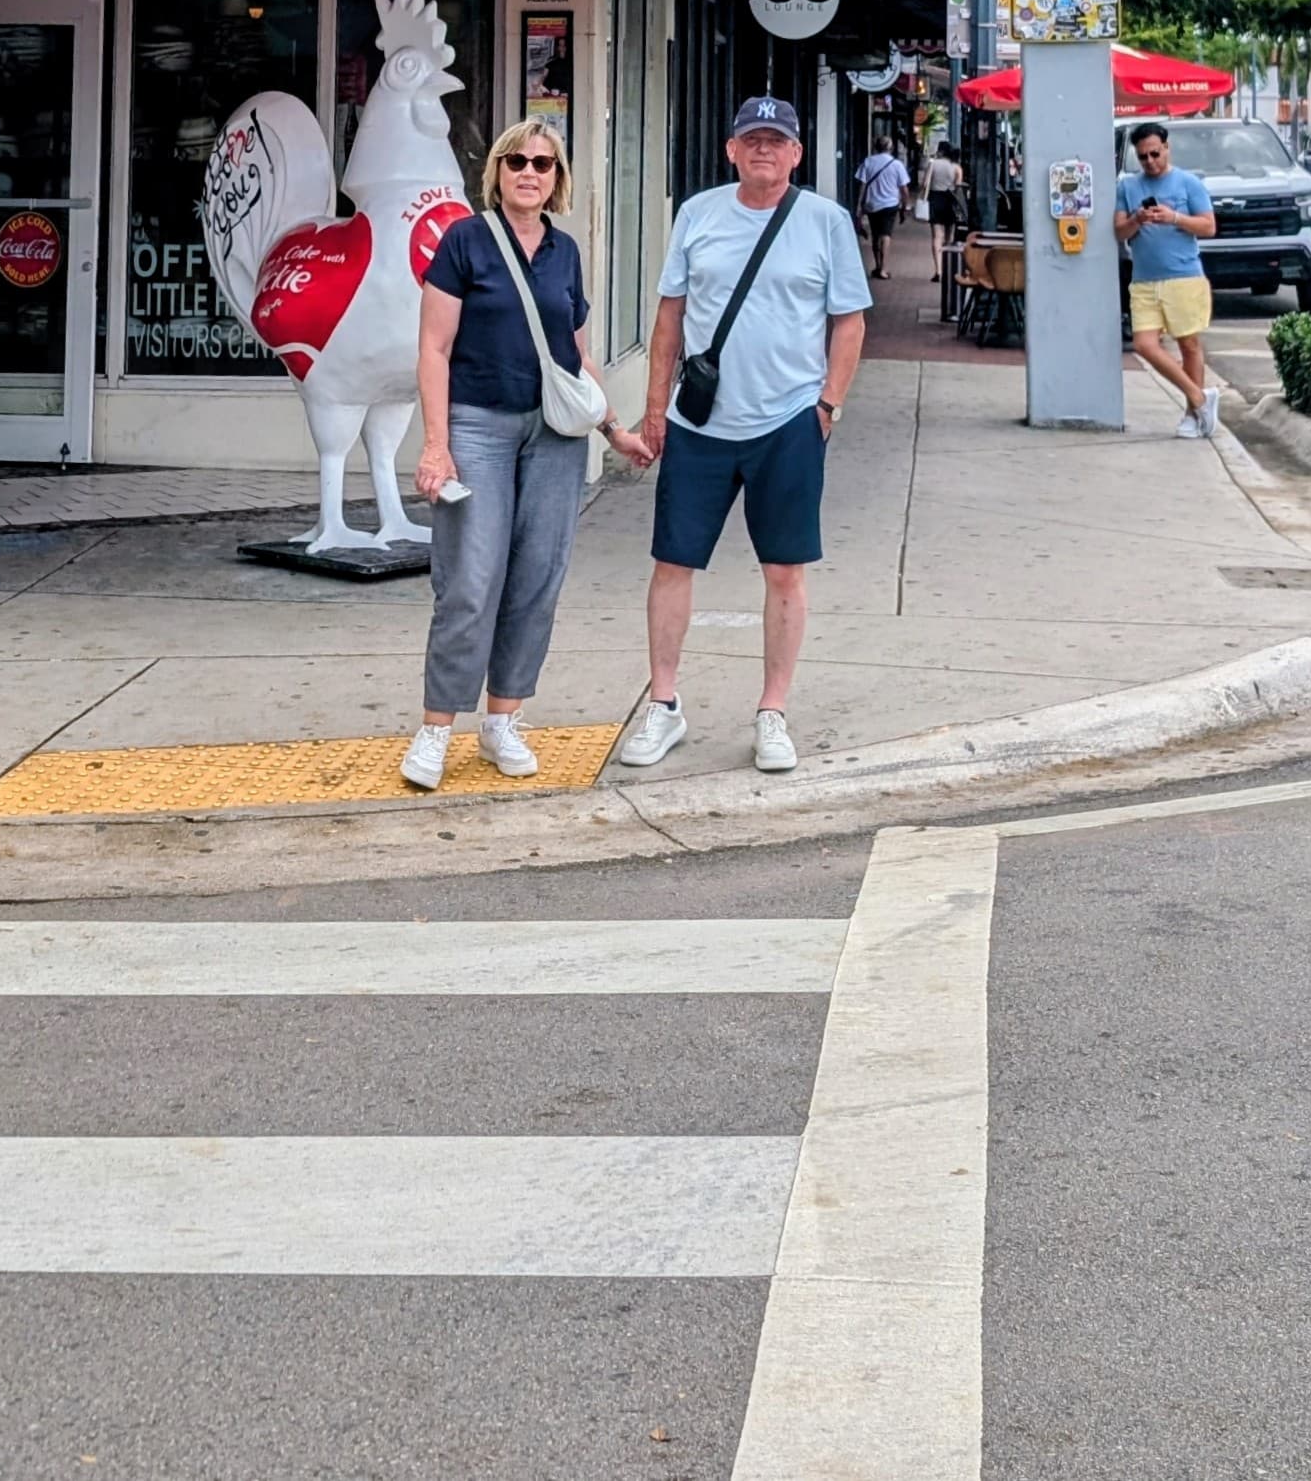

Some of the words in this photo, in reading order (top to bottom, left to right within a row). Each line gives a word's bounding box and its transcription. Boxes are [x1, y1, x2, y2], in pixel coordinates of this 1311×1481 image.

[765, 2, 824, 12] LOUNGE
[401, 210, 415, 223] I
[411, 186, 452, 211] LOVE
[8, 216, 25, 233] ICE
[26, 215, 53, 235] COLD
[132, 282, 208, 316] LITTLE
[133, 324, 222, 359] VISITORS
